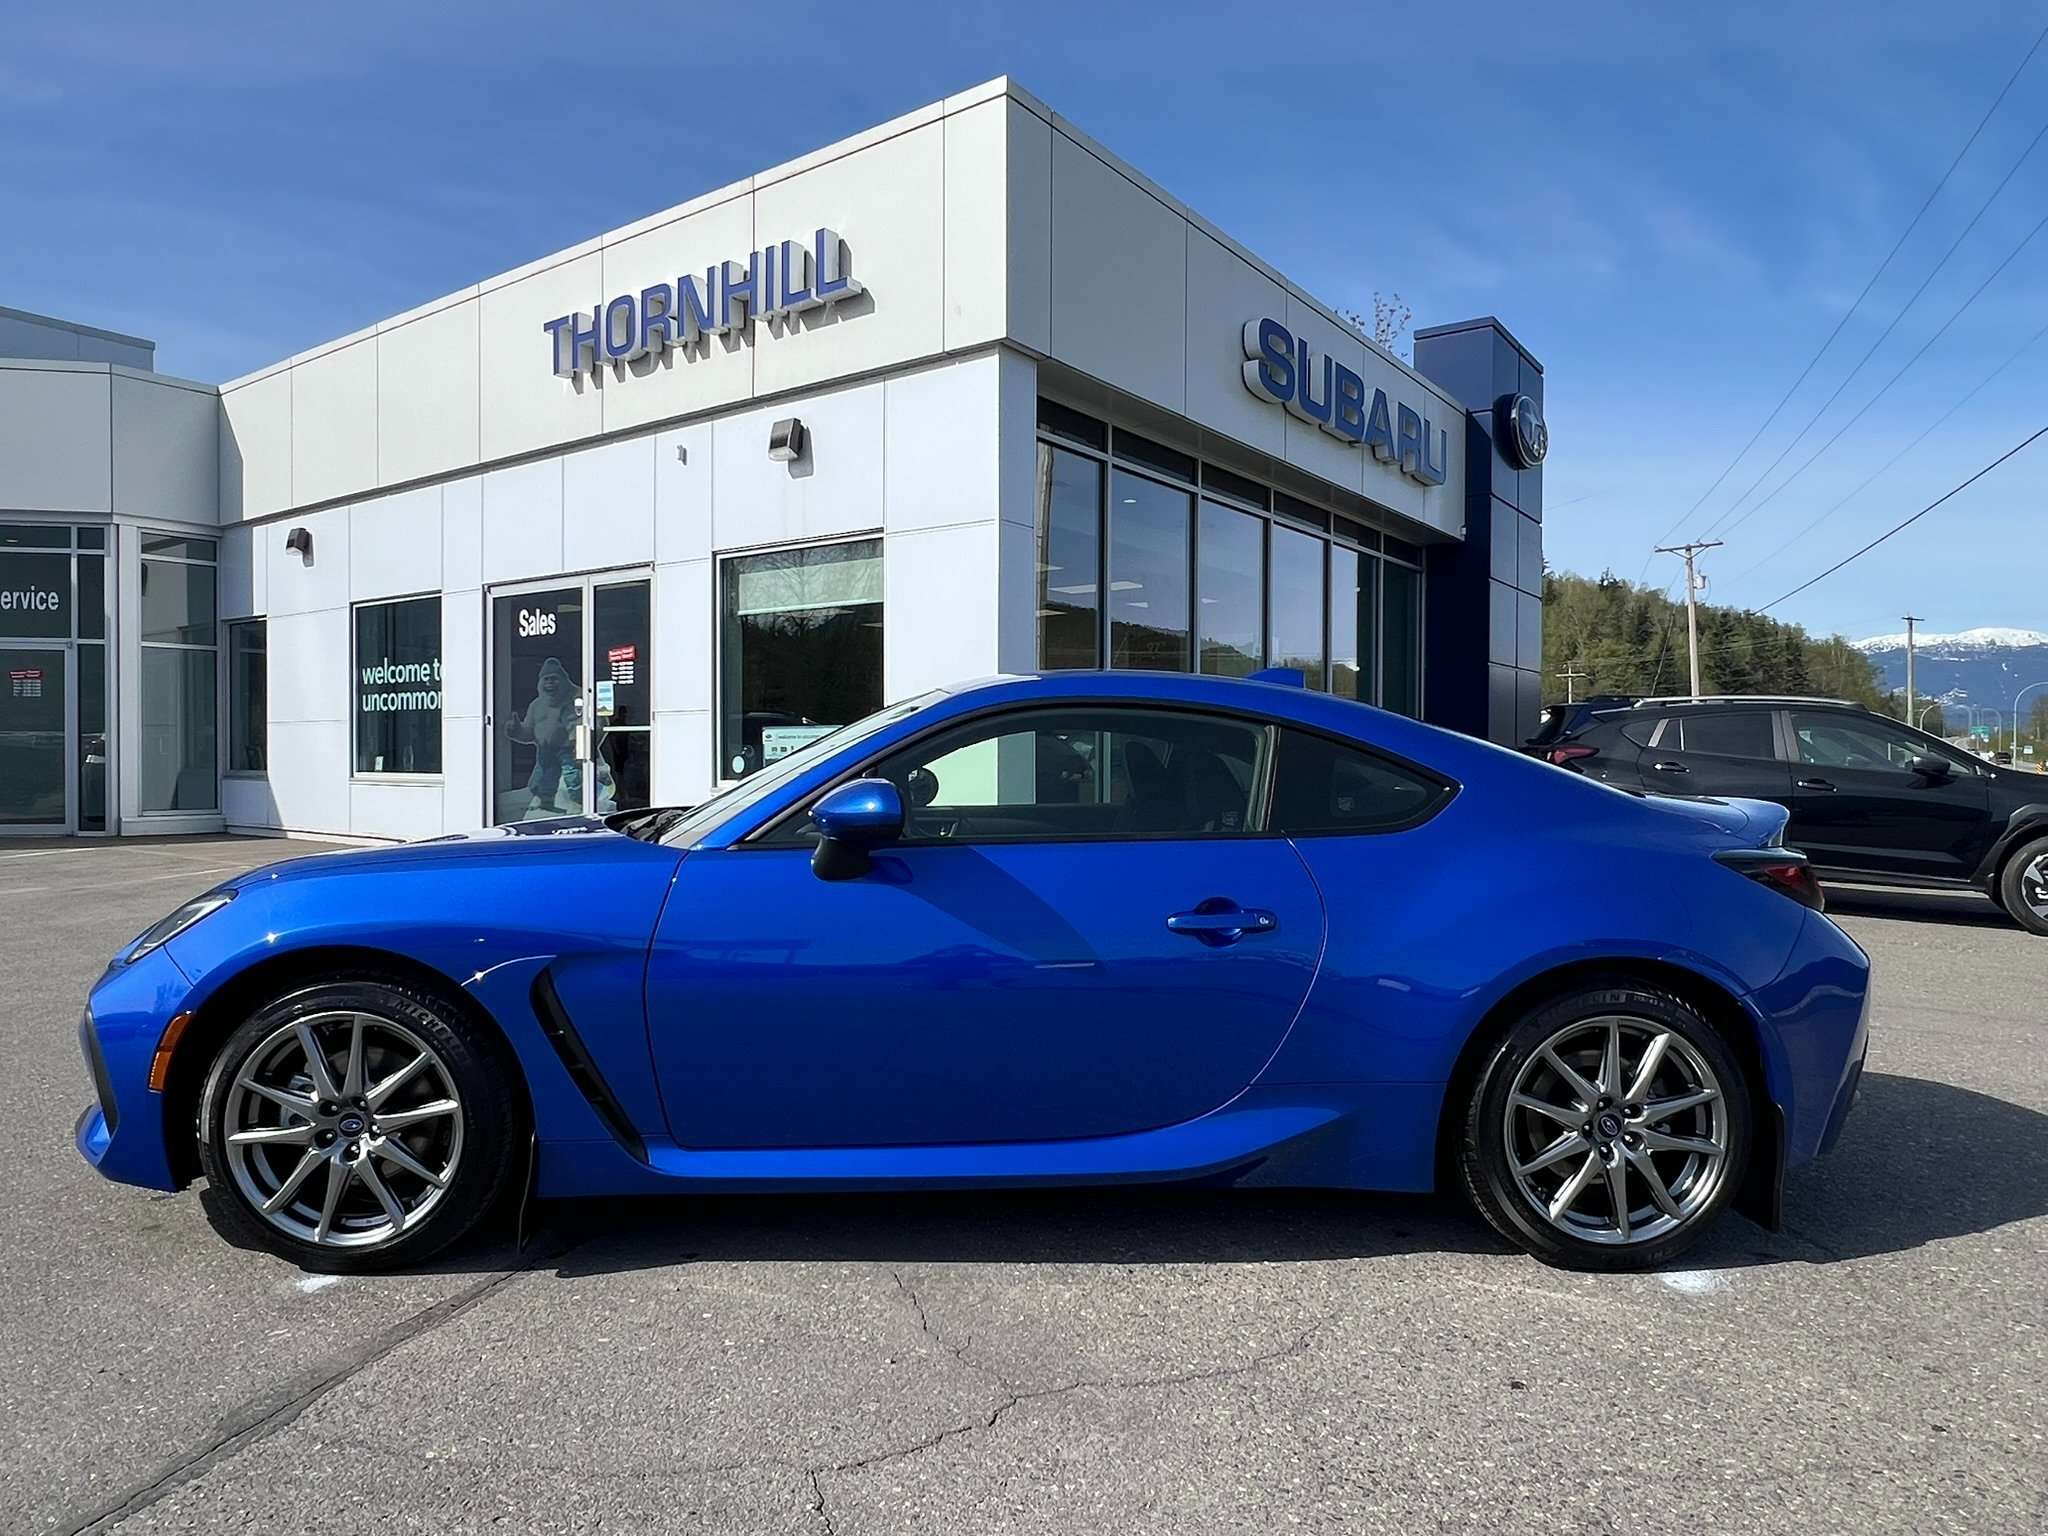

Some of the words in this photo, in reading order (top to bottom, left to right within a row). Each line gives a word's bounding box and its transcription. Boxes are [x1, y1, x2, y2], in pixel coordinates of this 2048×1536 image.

[543, 227, 858, 378] THORNHILL
[1243, 317, 1447, 486] SUBARU
[519, 608, 556, 637] Sales
[362, 657, 430, 685] welcome
